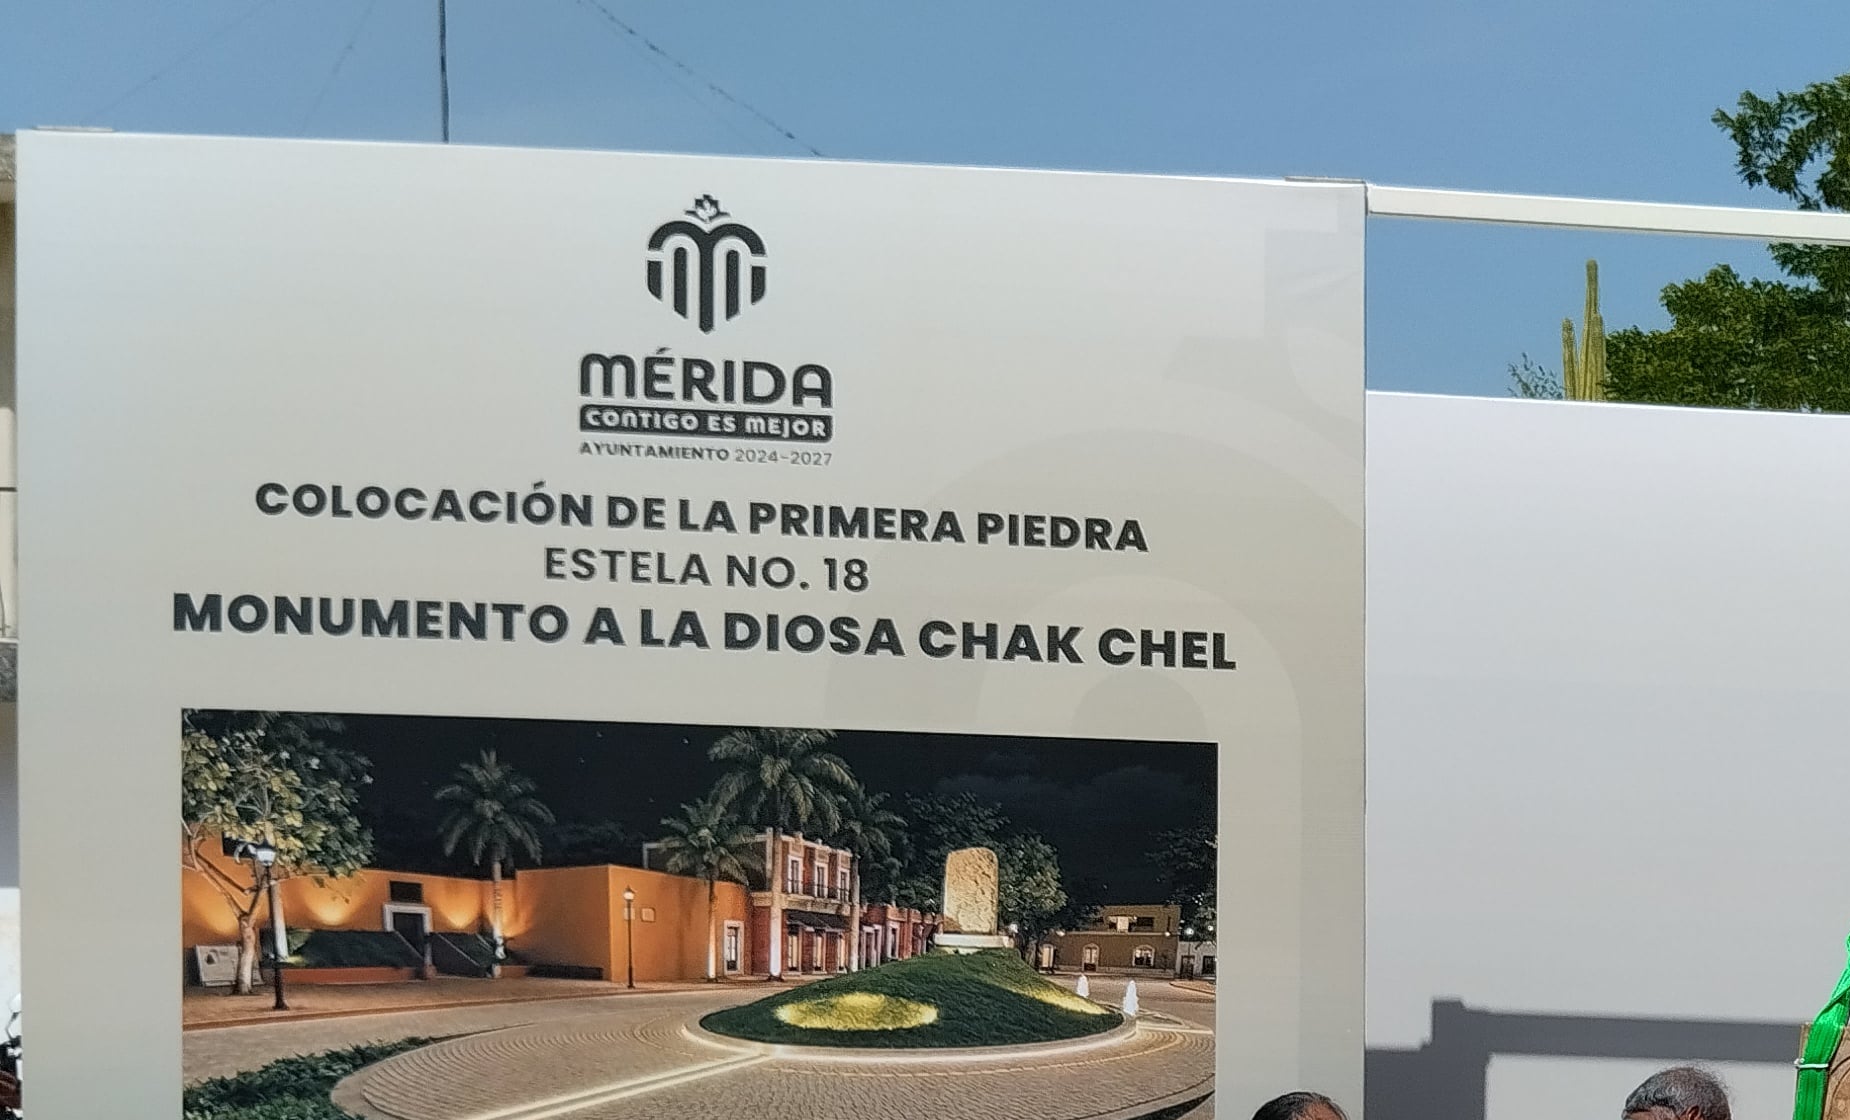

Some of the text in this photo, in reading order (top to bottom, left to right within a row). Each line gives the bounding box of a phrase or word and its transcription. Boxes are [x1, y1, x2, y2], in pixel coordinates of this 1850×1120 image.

[579, 346, 833, 409] MÉRIDA
[584, 406, 828, 439] CONTIGO ES MEJOR
[579, 441, 833, 466] AYUNTAMIENTO 2024-2027
[255, 480, 1149, 553] COLOCACIÓN DE LA PRIMERA PIEDRA
[544, 547, 869, 593] ESTELA NO. 18
[173, 592, 1237, 671] MONUMENTO A LA DIOSA CHAK CHEL
